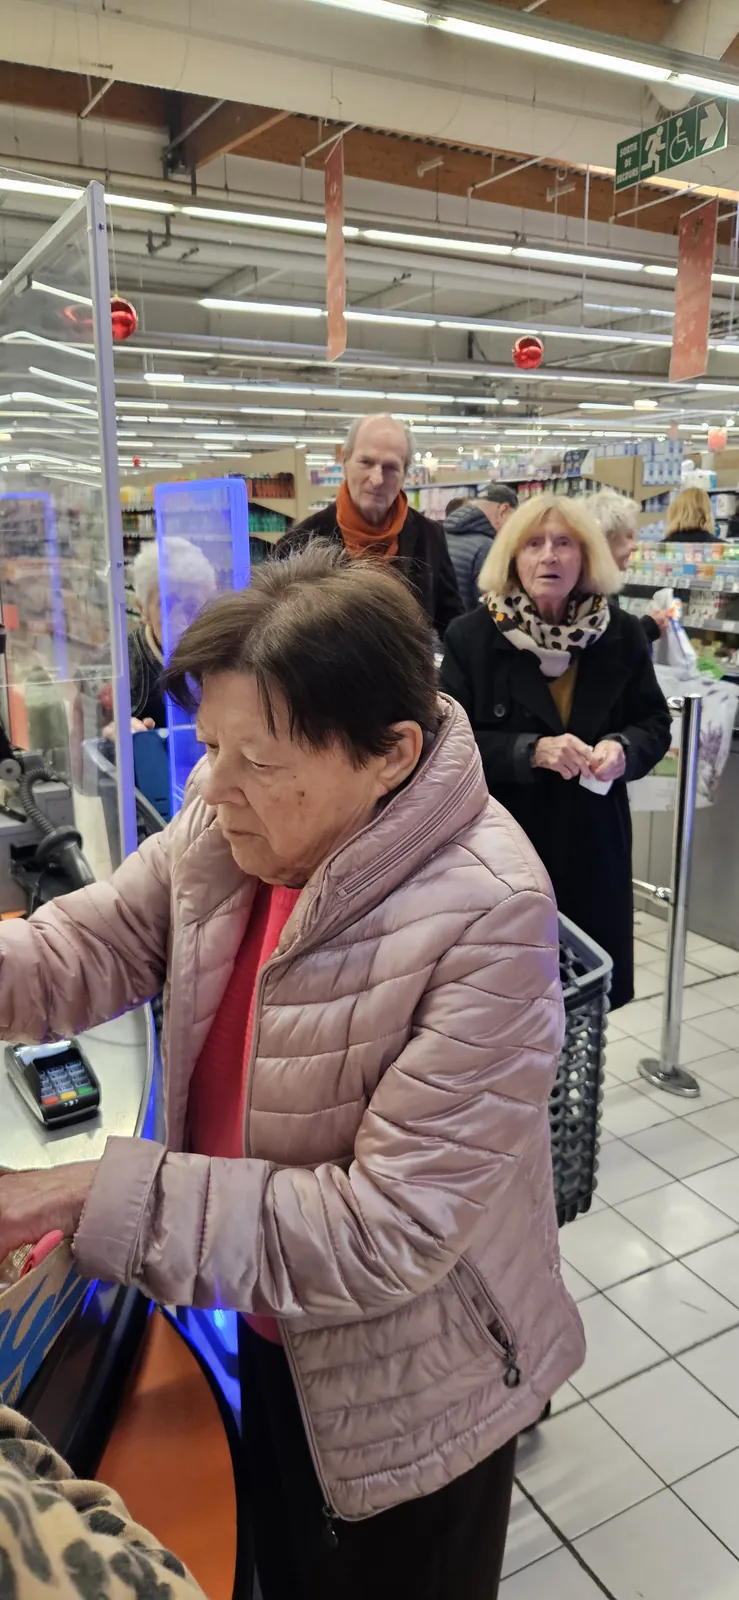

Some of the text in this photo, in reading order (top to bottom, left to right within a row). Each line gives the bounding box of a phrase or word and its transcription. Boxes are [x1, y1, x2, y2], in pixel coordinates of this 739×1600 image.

[620, 142, 638, 157] SORTIE
[624, 157, 632, 168] DE
[616, 167, 639, 184] SECOURS
